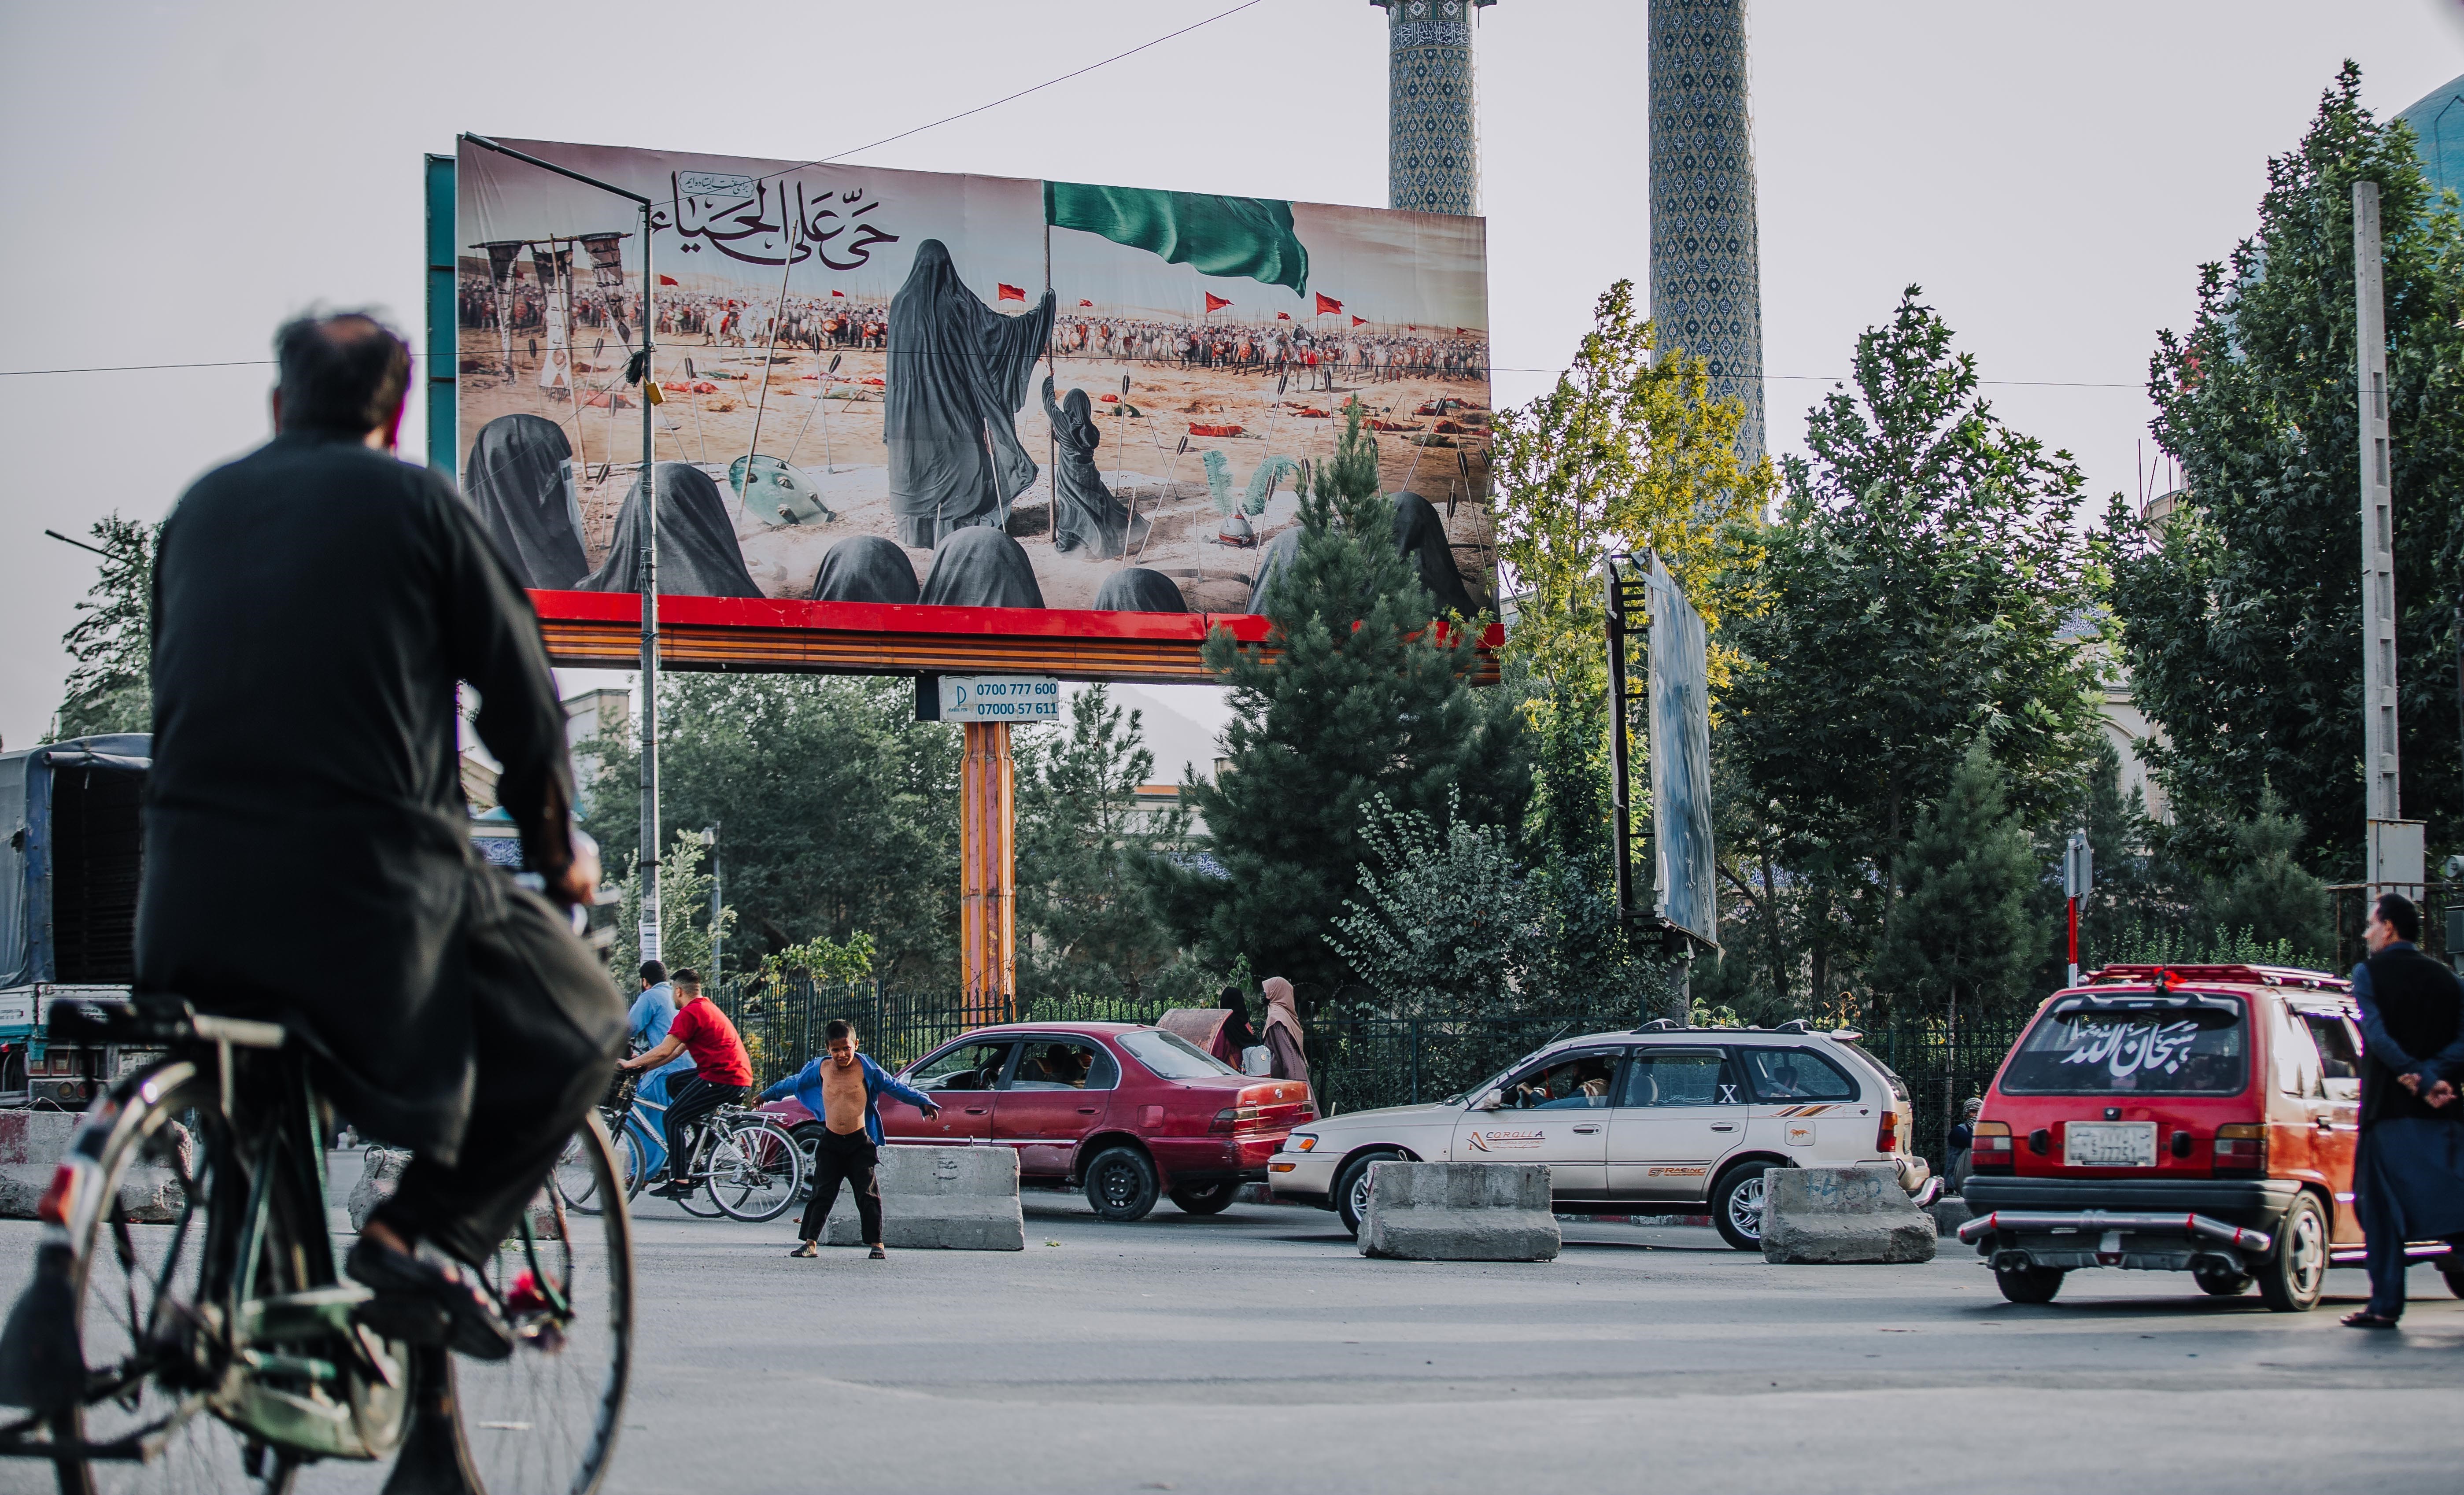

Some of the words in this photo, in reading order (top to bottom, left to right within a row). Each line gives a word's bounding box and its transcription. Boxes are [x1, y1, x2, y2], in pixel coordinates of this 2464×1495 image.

[977, 684, 1006, 695] 0700
[1010, 683, 1031, 695] 777
[1035, 683, 1057, 694] 600
[977, 704, 1014, 715] 07000
[1018, 703, 1032, 714] 57
[1035, 703, 1057, 714] 611
[1718, 1084, 1738, 1103] X
